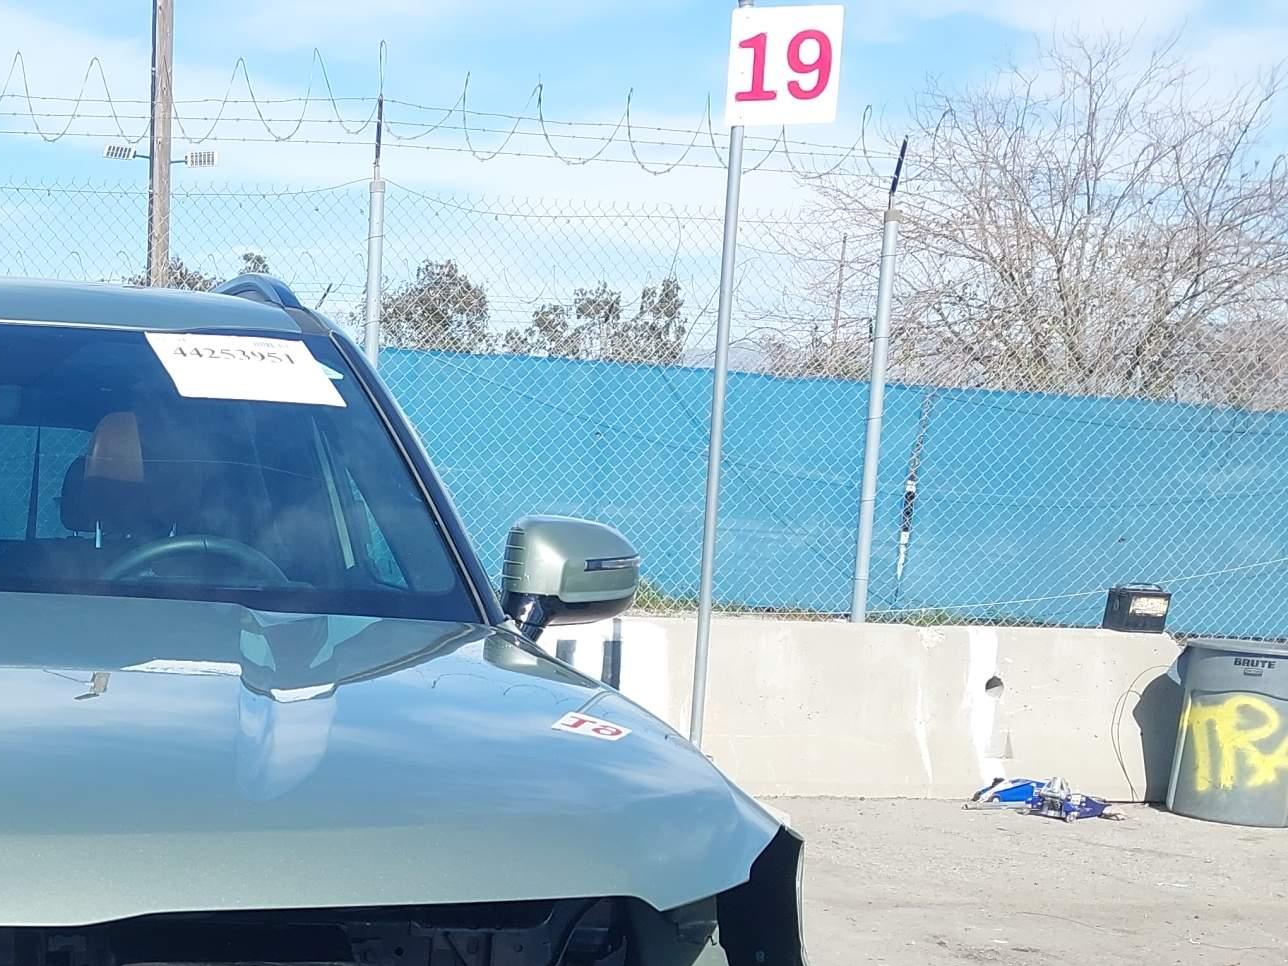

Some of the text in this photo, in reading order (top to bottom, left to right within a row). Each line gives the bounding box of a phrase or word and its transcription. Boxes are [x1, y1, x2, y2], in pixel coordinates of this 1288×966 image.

[734, 29, 833, 102] 19
[172, 346, 295, 364] 44253951
[1233, 657, 1276, 669] BRUTE
